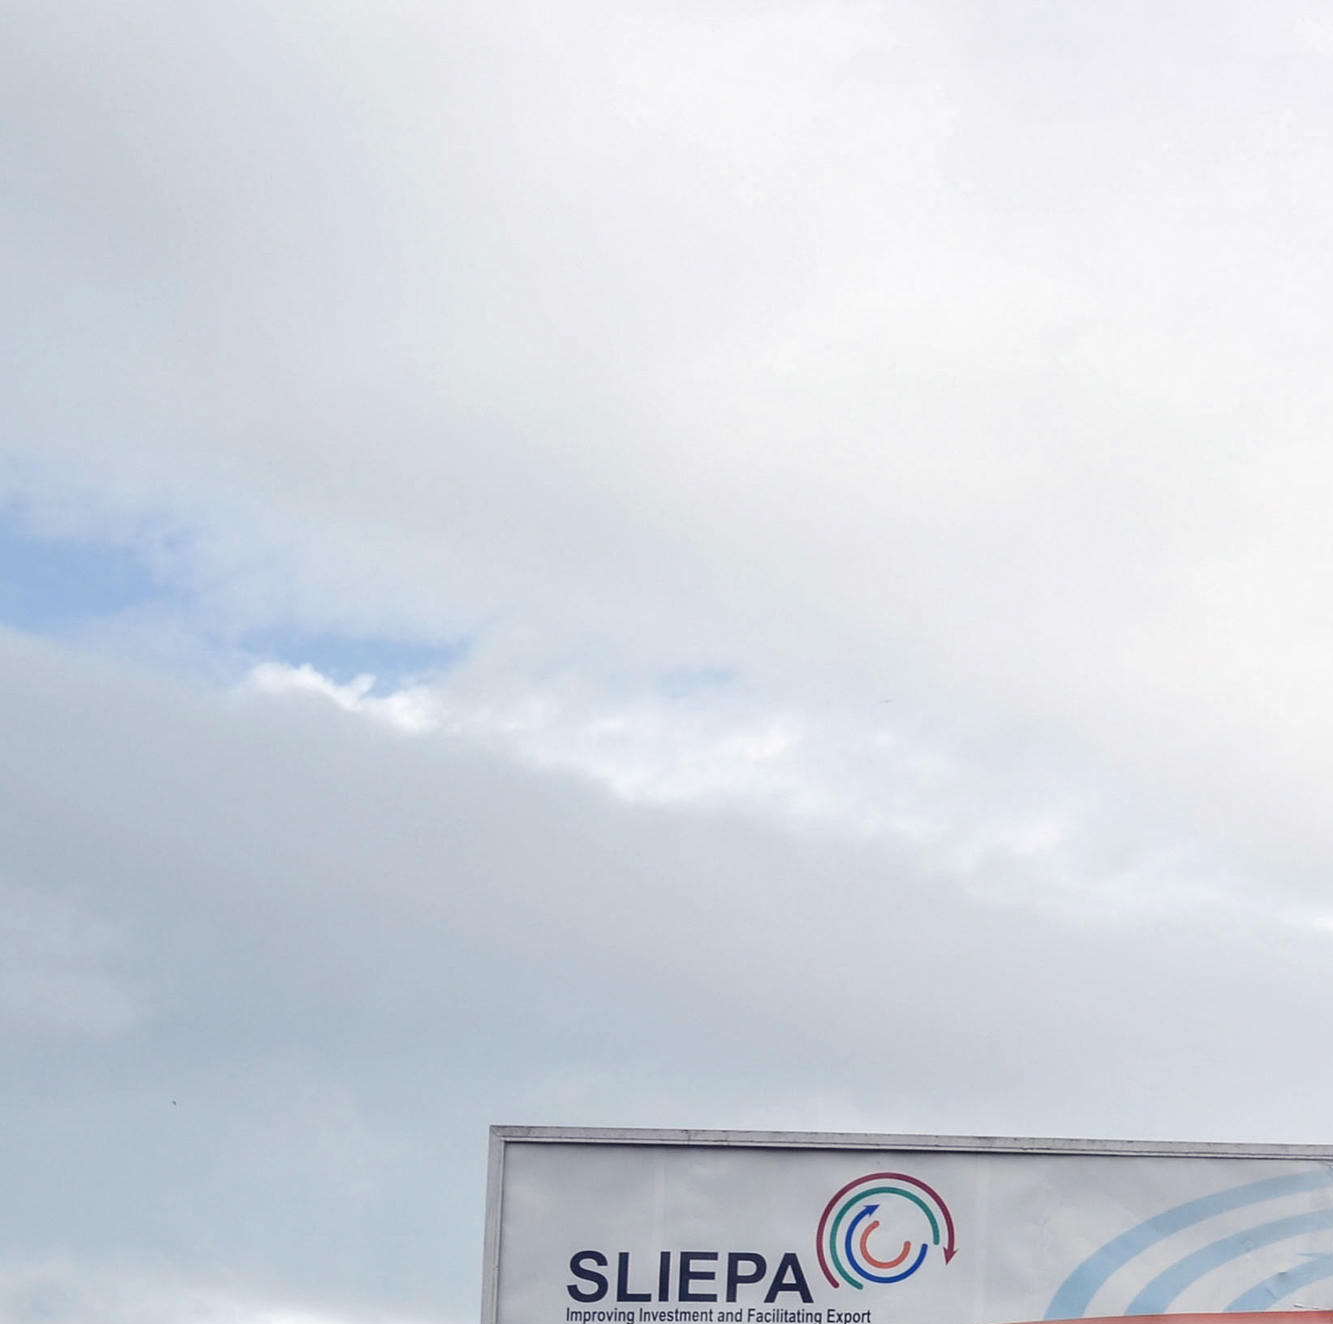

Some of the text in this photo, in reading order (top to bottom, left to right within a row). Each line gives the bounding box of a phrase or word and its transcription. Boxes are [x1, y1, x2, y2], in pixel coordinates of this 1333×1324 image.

[566, 1250, 815, 1304] SLIEPA
[639, 1307, 714, 1323] Investment
[717, 1308, 743, 1323] and
